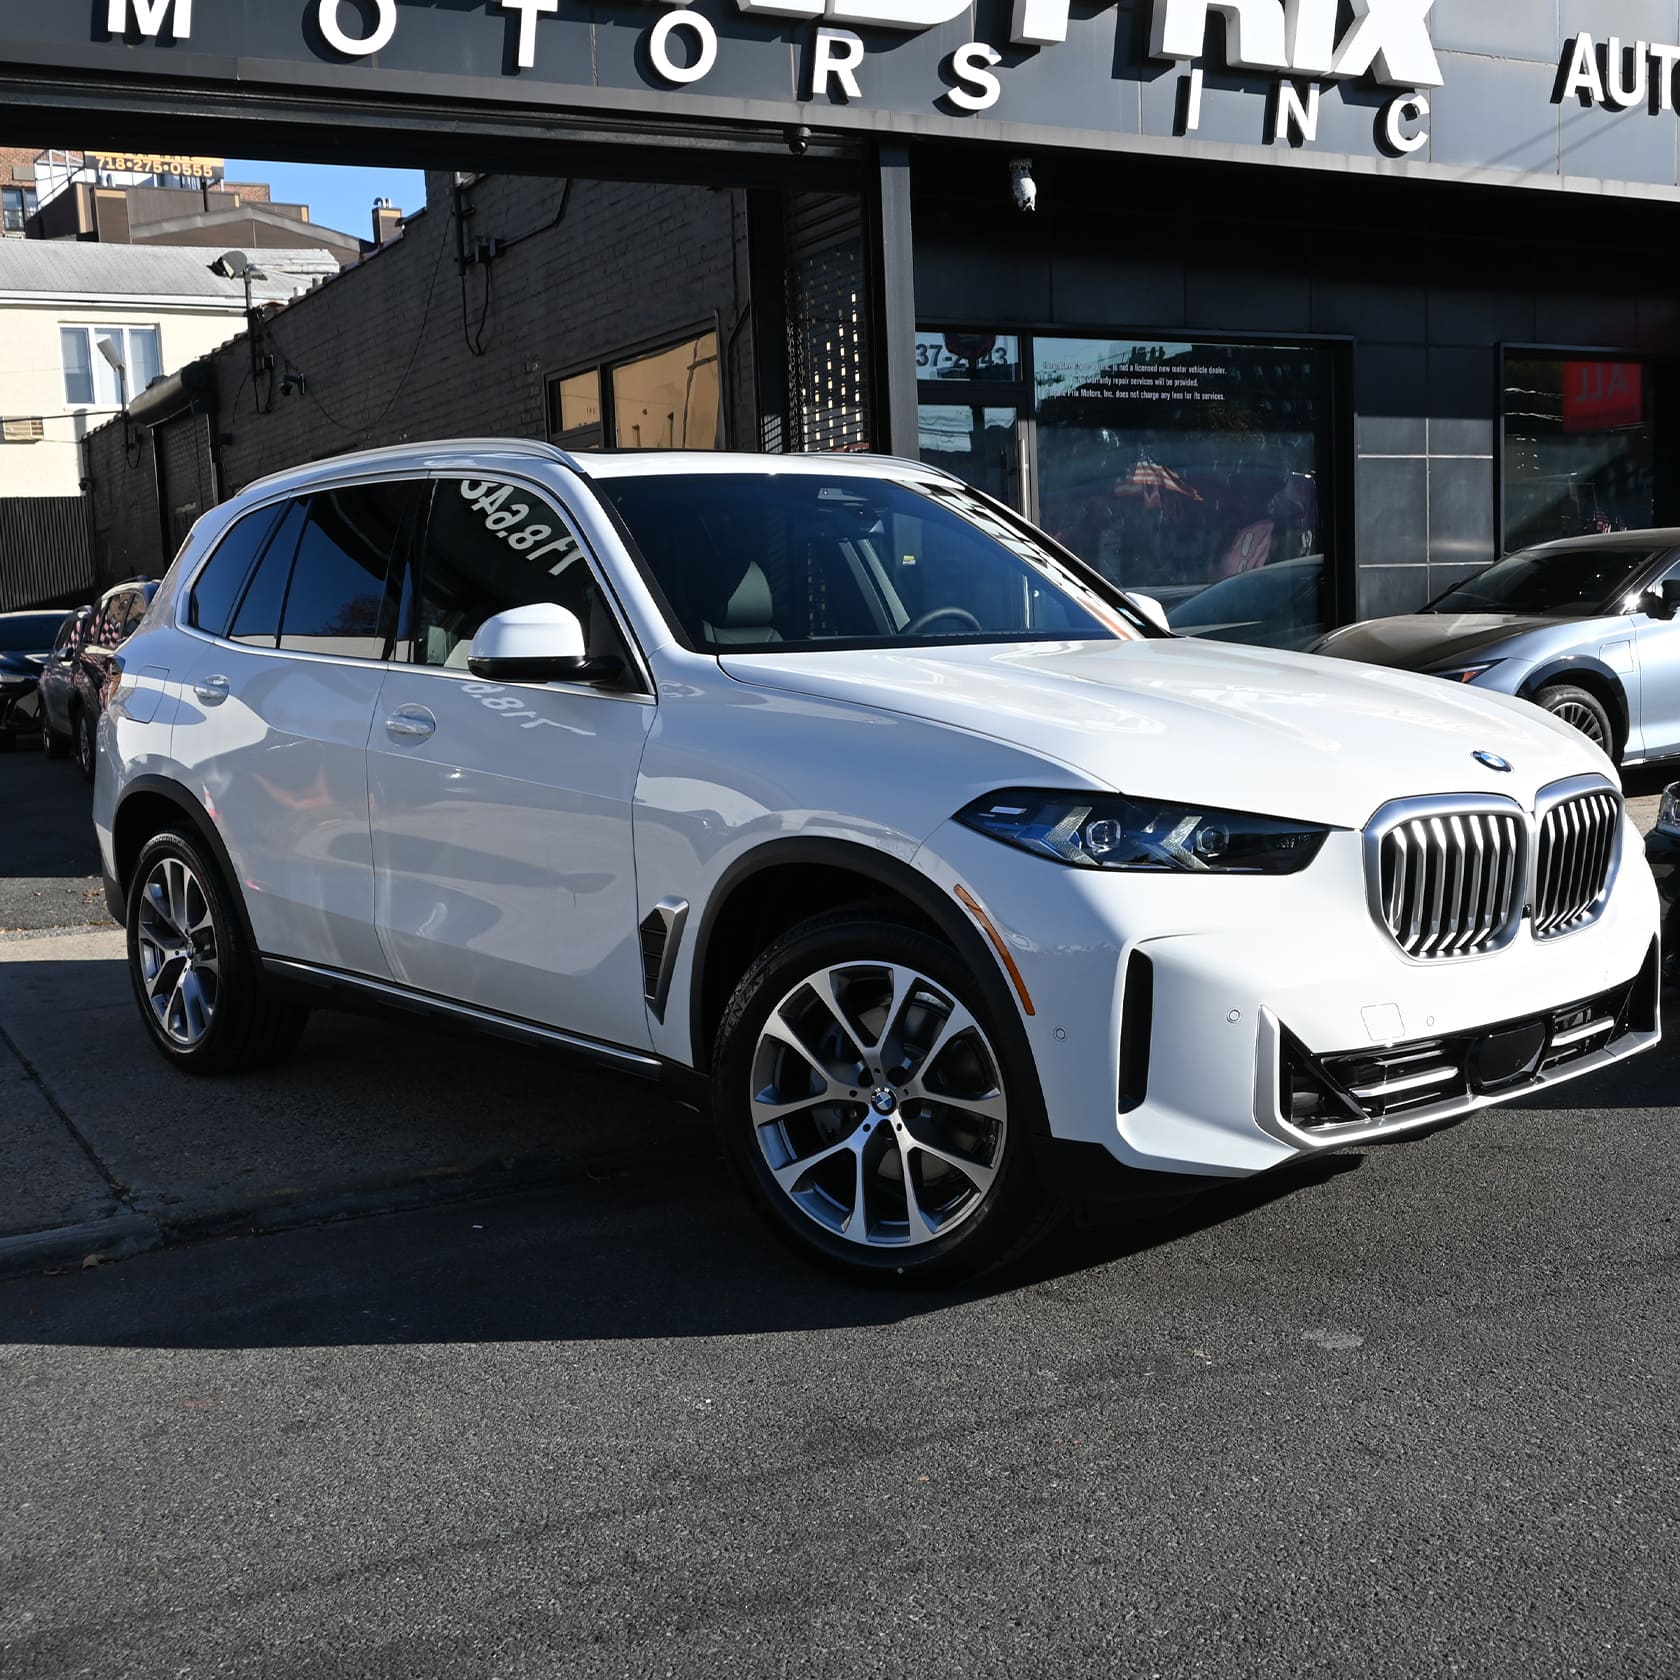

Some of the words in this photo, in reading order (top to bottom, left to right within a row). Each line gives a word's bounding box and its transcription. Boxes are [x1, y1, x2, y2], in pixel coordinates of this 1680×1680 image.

[106, 0, 1002, 113] MOTORS
[1186, 66, 1430, 152] INC
[1119, 363, 1129, 372] not
[1134, 363, 1158, 373] licensed
[1158, 365, 1171, 373] new
[1171, 364, 1187, 373] motor
[1188, 365, 1208, 374] vehicle
[1208, 365, 1228, 375] dealer.
[1112, 376, 1130, 387] repair
[1130, 377, 1154, 386] services
[1154, 377, 1165, 386] will
[1165, 378, 1173, 386] be
[1174, 378, 1199, 388] provided.
[1080, 388, 1103, 399] Motors,
[1103, 389, 1115, 398] Inc.
[1115, 389, 1129, 398] does
[1129, 389, 1140, 399] not
[1140, 390, 1160, 401] charge
[1160, 391, 1171, 401] any
[1171, 391, 1184, 400] fees
[1184, 391, 1193, 400] for
[1201, 391, 1225, 401] services.
